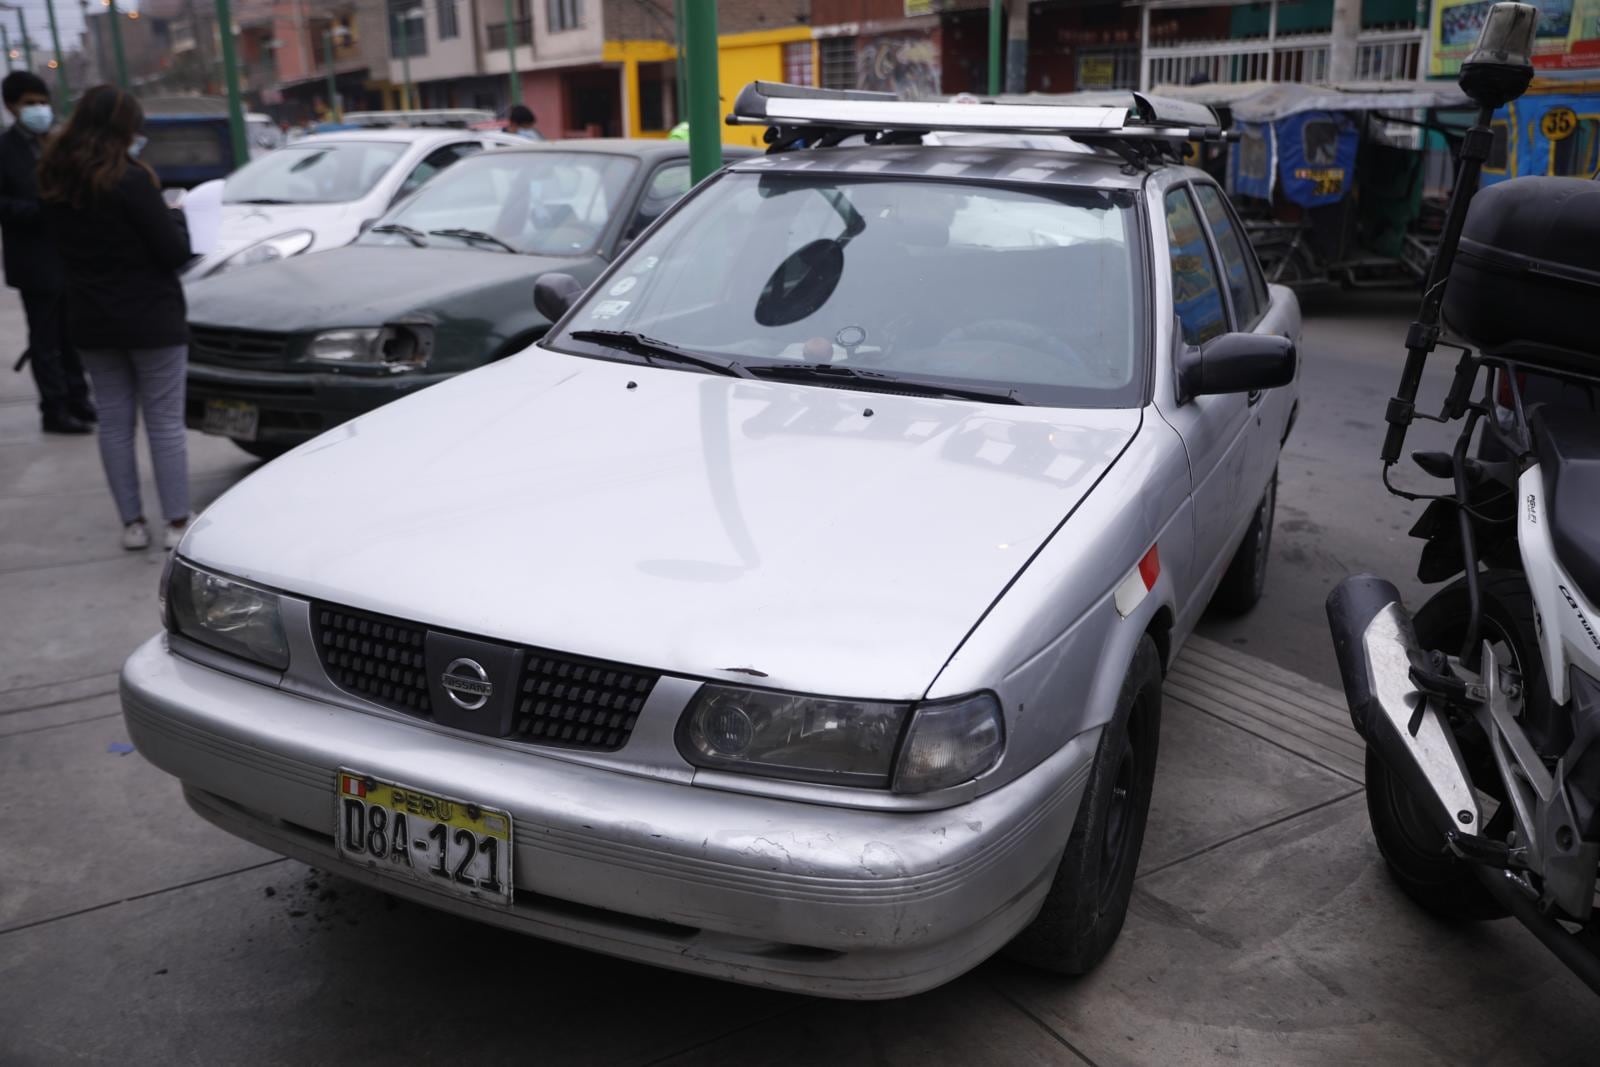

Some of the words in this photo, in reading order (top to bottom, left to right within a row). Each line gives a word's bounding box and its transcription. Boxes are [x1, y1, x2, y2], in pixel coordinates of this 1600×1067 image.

[446, 677, 491, 695] NISSAN
[391, 790, 453, 821] PERU
[345, 798, 502, 892] D8A-121
